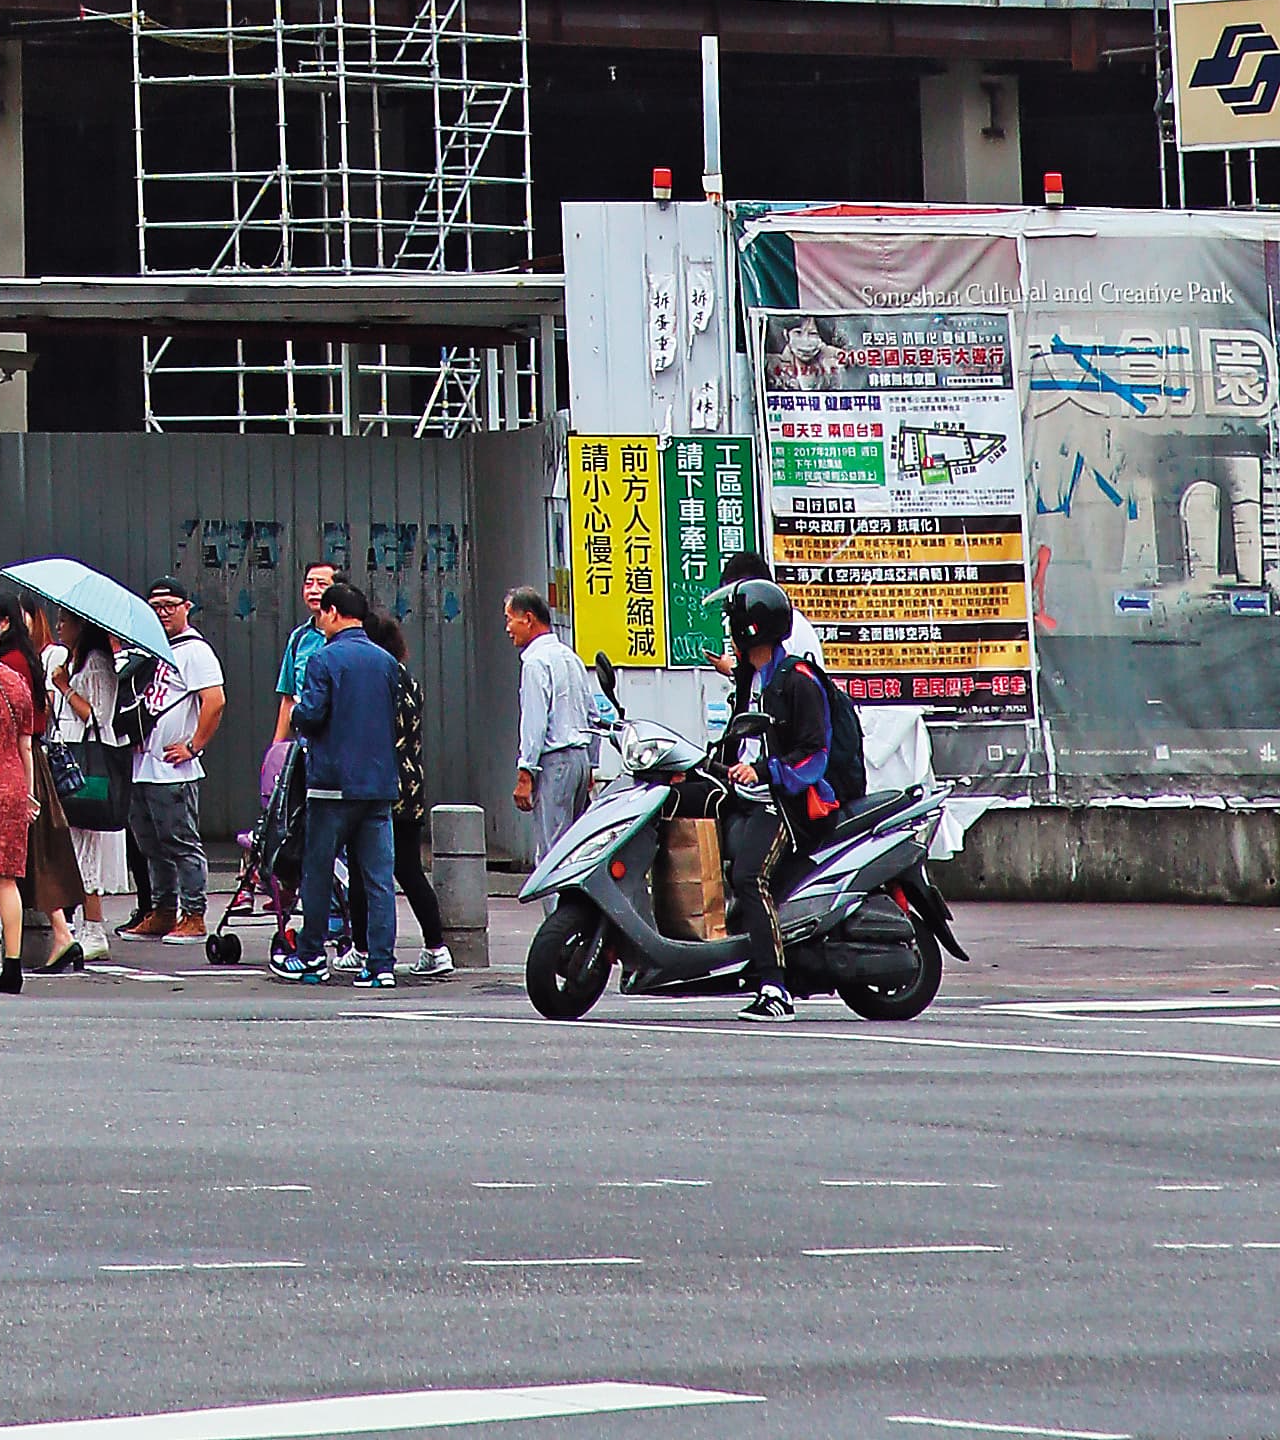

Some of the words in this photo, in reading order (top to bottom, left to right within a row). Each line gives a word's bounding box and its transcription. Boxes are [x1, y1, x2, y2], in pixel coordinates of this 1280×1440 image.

[837, 346, 1005, 367] 219全國反空污大遊行
[861, 284, 960, 308] Songshan
[965, 280, 1048, 306] Cultual
[1053, 281, 1093, 305] and
[1102, 280, 1184, 305] Creative
[1188, 281, 1234, 305] Park
[581, 443, 614, 596] 請小心慢行
[620, 443, 656, 658] 前方人行道縮減
[676, 442, 708, 581] 請下車牽行
